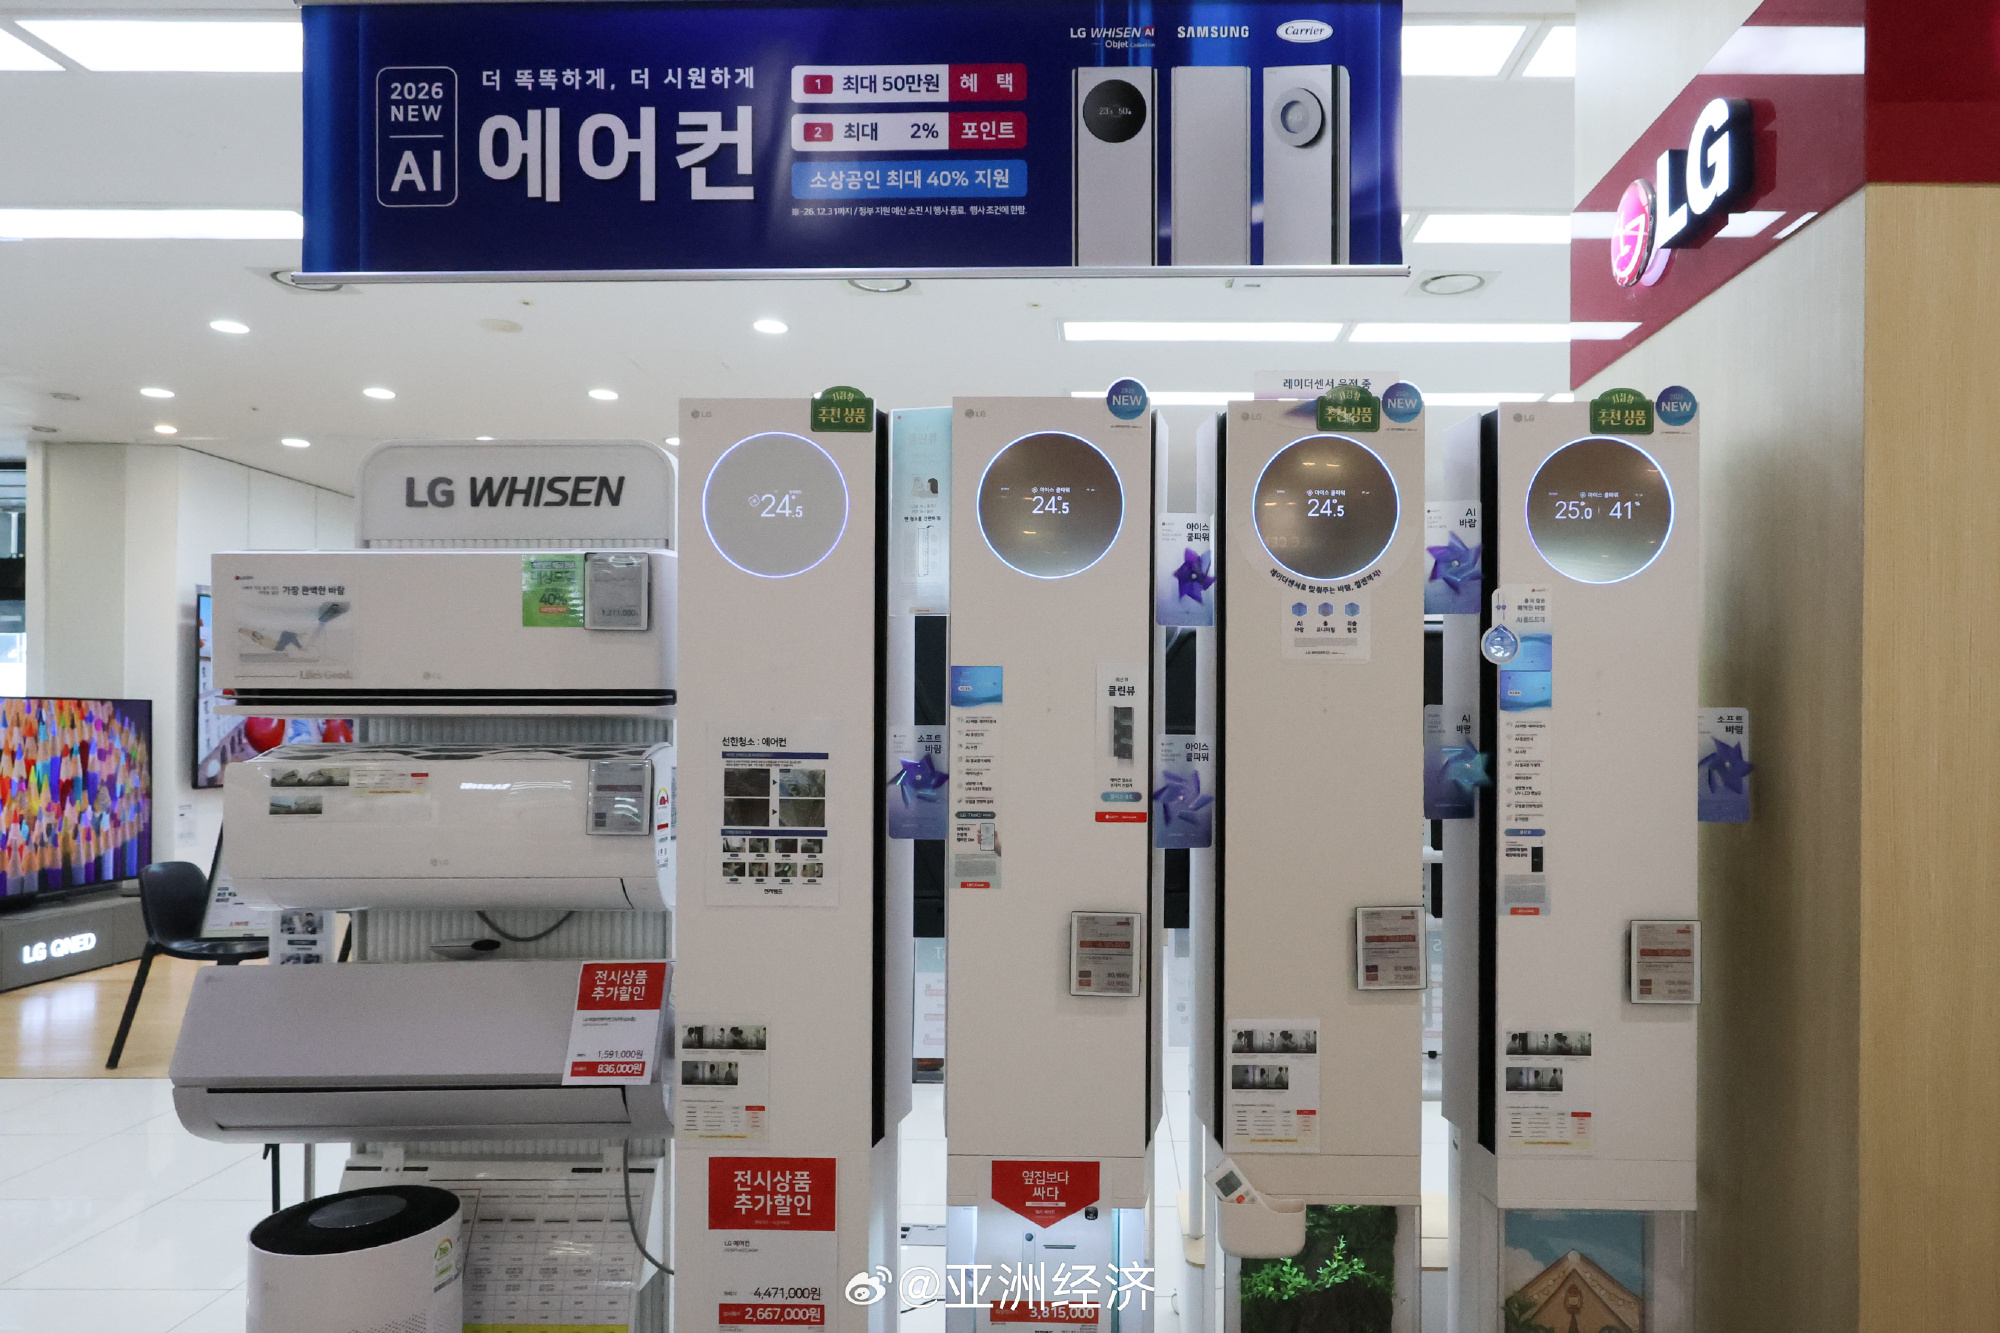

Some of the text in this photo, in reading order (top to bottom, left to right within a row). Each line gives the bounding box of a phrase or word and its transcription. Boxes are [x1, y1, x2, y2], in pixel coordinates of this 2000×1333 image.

[1070, 27, 1155, 38] LG WHISEN AI
[1178, 26, 1249, 39] SAMSUNG
[1285, 26, 1325, 36] Carrier
[1105, 40, 1128, 49] Objet
[482, 65, 755, 91] 더 똑똑하게, 더 시원하게
[814, 78, 822, 90] 1
[842, 75, 877, 94] 최대
[882, 74, 940, 93] 50만원
[390, 82, 444, 100] 2026
[390, 104, 442, 122] NEW
[814, 121, 1015, 141] 2 최대 2% 포인트
[478, 105, 755, 202] 에어컨
[390, 150, 442, 192] AI
[1657, 98, 1730, 249] LG
[810, 168, 1009, 189] 소상공인 최대 40% 지원
[1283, 378, 1335, 390] 레이더센서
[1361, 379, 1372, 390] 중
[1112, 394, 1143, 406] NEW
[1387, 398, 1418, 409] NEW
[1661, 402, 1692, 413] NEW
[818, 407, 866, 423] 추천 상품
[1598, 409, 1647, 426] 추천 상품
[405, 476, 625, 507] LG WHISEN
[1465, 508, 1477, 517] AI
[1186, 522, 1210, 532] 아이스
[1459, 518, 1477, 528] 바람
[1186, 533, 1210, 542] 쿨파워
[282, 585, 299, 595] 가장
[301, 585, 325, 595] 완벽한
[327, 585, 345, 595] 바람
[539, 593, 568, 606] 40%
[1108, 686, 1135, 696] 클린뷰
[1462, 715, 1471, 723] AI
[1717, 715, 1744, 724] 소프트
[1456, 725, 1471, 734] 바람
[1725, 725, 1744, 735] 바람
[722, 736, 755, 746] 선한청소
[761, 737, 787, 748] 에어컨
[917, 734, 942, 744] 소프트
[925, 744, 942, 754] 바람
[1185, 742, 1209, 752] 아이스
[1185, 752, 1209, 762] 쿨파워
[22, 932, 97, 964] LG QNED
[595, 970, 648, 985] 전시상품
[591, 986, 645, 1001] 추가할인
[598, 1050, 643, 1059] 1,591,000원
[597, 1063, 643, 1074] 836,000원
[734, 1170, 812, 1193] 전시상품
[1023, 1170, 1070, 1185] 옆집보다
[1032, 1186, 1060, 1200] 싸다
[734, 1193, 812, 1217] 추가할인
[753, 1287, 821, 1301] 4,471,000원
[745, 1307, 821, 1322] 2,667,000원
[1029, 1305, 1095, 1320] 3,815,000
